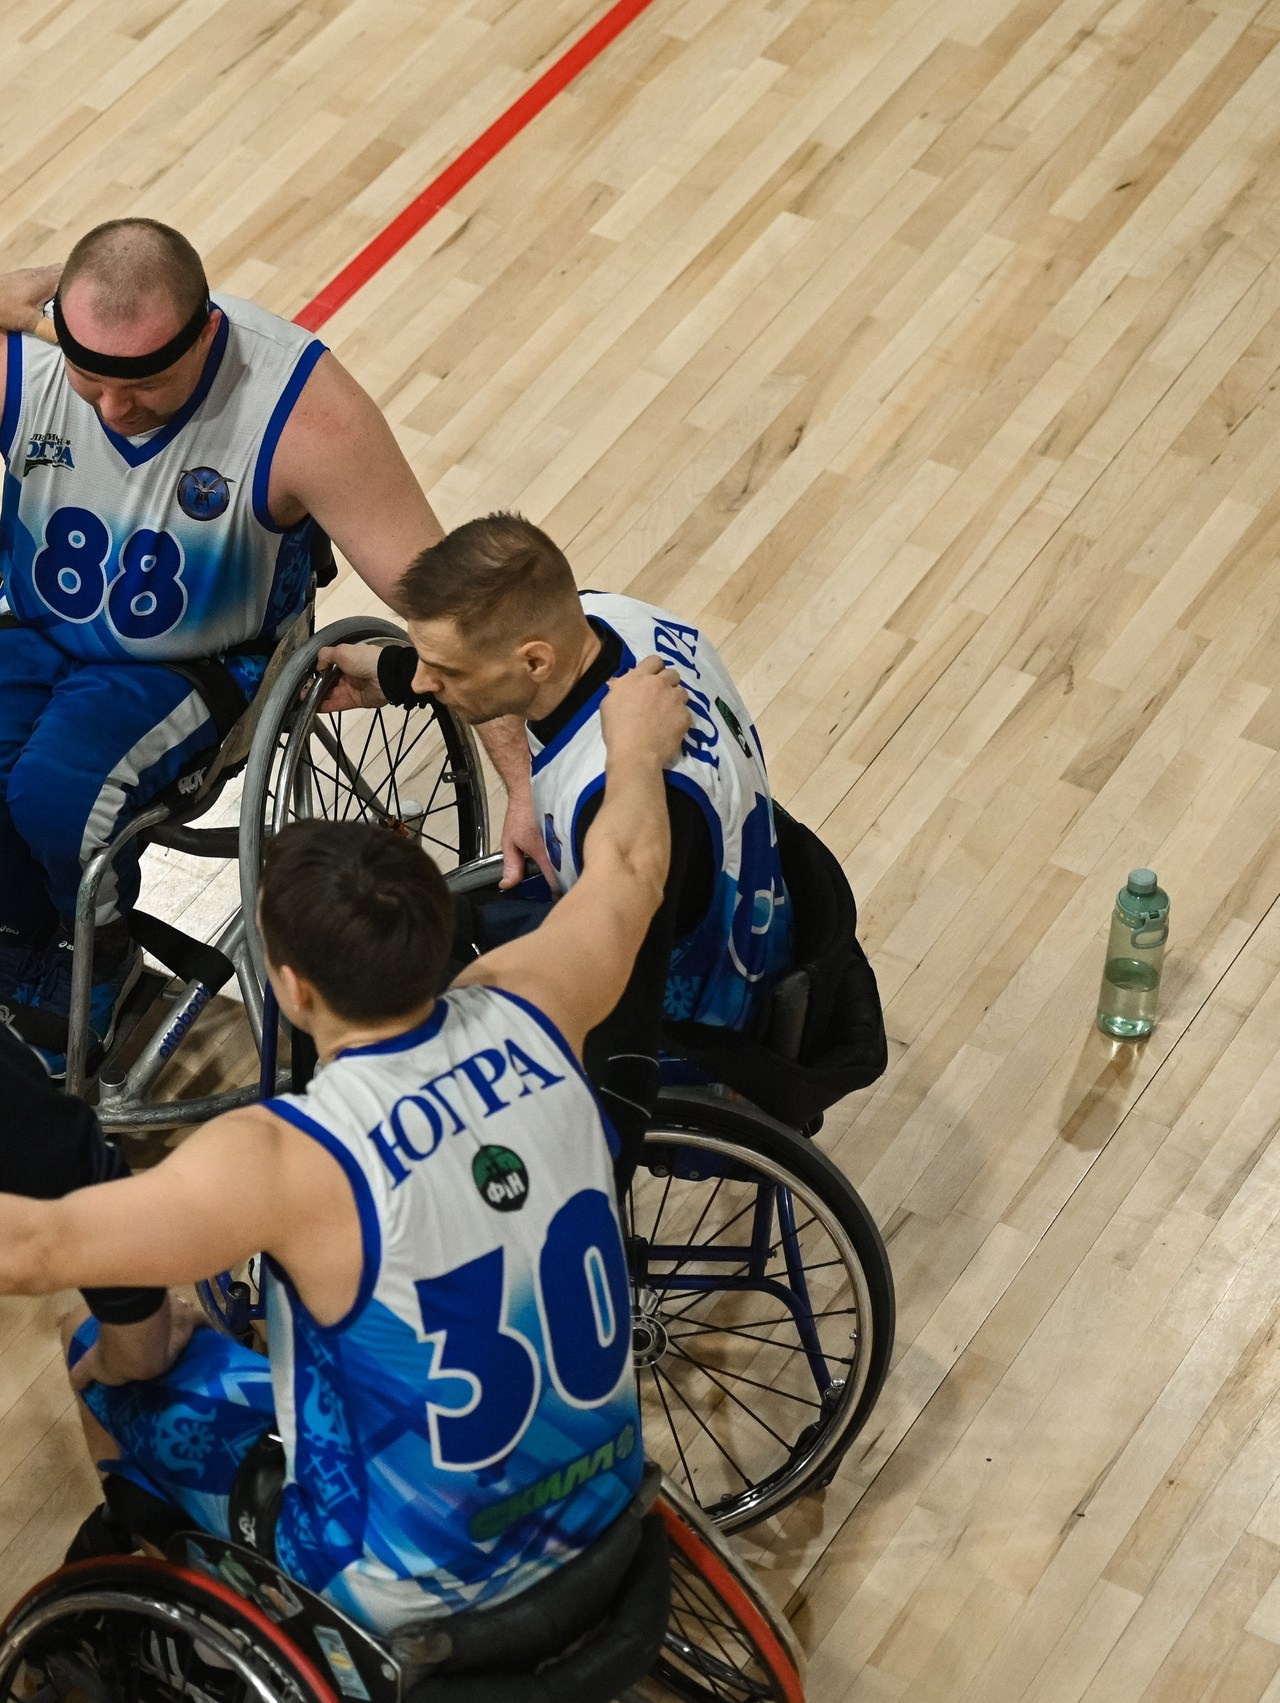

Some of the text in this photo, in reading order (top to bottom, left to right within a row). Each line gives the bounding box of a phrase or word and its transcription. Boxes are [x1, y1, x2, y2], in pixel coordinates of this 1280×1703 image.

[32, 506, 188, 640] 88
[367, 1038, 566, 1192] ЮГРА
[414, 1187, 634, 1473] 30
